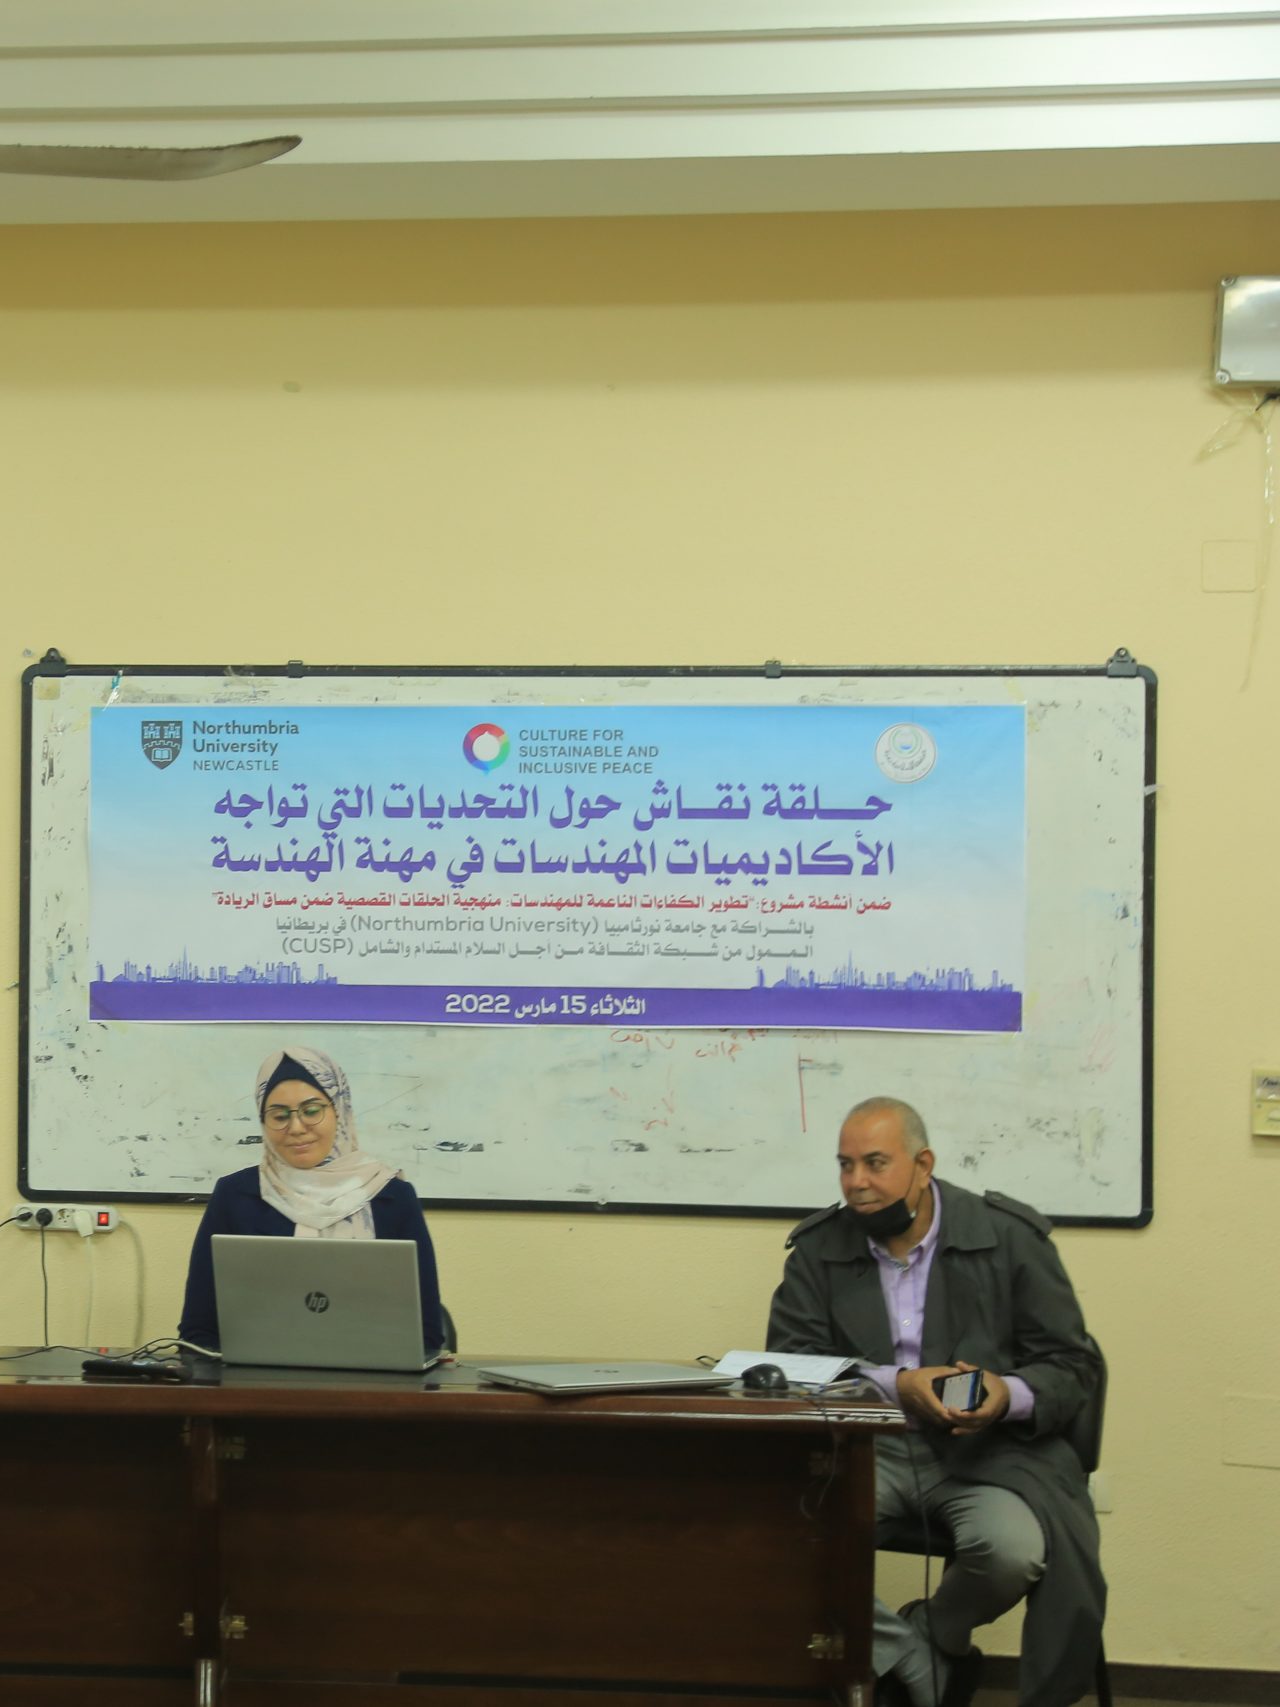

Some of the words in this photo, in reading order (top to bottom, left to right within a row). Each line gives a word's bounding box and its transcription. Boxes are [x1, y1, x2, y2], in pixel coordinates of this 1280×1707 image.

[193, 720, 299, 735] Northumbria
[519, 729, 588, 741] CULTURE
[593, 729, 624, 741] FOR
[193, 739, 279, 756] University
[519, 746, 622, 758] SUSTAINABLE
[627, 746, 659, 758] AND
[193, 760, 279, 771] NEWCASTLE
[519, 762, 597, 774] INCLUSIVE
[602, 762, 653, 774] PEACE
[213, 783, 309, 829] تواجه
[317, 784, 373, 831] التي
[383, 783, 539, 830] التحديات
[549, 784, 622, 829] حول
[633, 779, 751, 831] نقاش
[761, 783, 893, 820] حلقة
[210, 832, 345, 883] الهندسة
[353, 837, 437, 883] مهنة
[447, 835, 485, 889] في
[493, 838, 657, 884] المهندسات
[666, 830, 895, 887] الأكاديميات
[262, 892, 297, 909] مساق
[300, 892, 334, 910] ضمن
[337, 892, 396, 910] القصصية
[399, 892, 450, 907] الحلقات
[453, 893, 501, 911] منهجية
[587, 893, 637, 909] الناعمة
[640, 894, 705, 910] الكفاءات
[856, 896, 892, 915] ضمن
[276, 916, 329, 934] بريطانيا
[332, 916, 347, 935] في
[351, 915, 484, 933] (Northumbria
[490, 916, 599, 936] University)
[604, 917, 660, 937] نورثامبيا
[664, 919, 706, 938] جامعة
[710, 922, 727, 938] مع
[731, 919, 814, 939] بالشراكة
[282, 937, 354, 955] (CUSP)
[359, 938, 410, 958] والشامل
[413, 941, 462, 958] المستدام
[465, 942, 505, 957] السلام
[554, 944, 584, 959] من
[588, 941, 649, 957] الثقافة
[653, 943, 718, 961] شبكة
[722, 946, 742, 961] من
[746, 944, 813, 961] الممول
[445, 994, 510, 1013] 2022
[514, 997, 557, 1019] مارس
[560, 995, 587, 1014] 15
[590, 993, 646, 1017] الثلاثاء
[307, 1291, 328, 1313] hp
